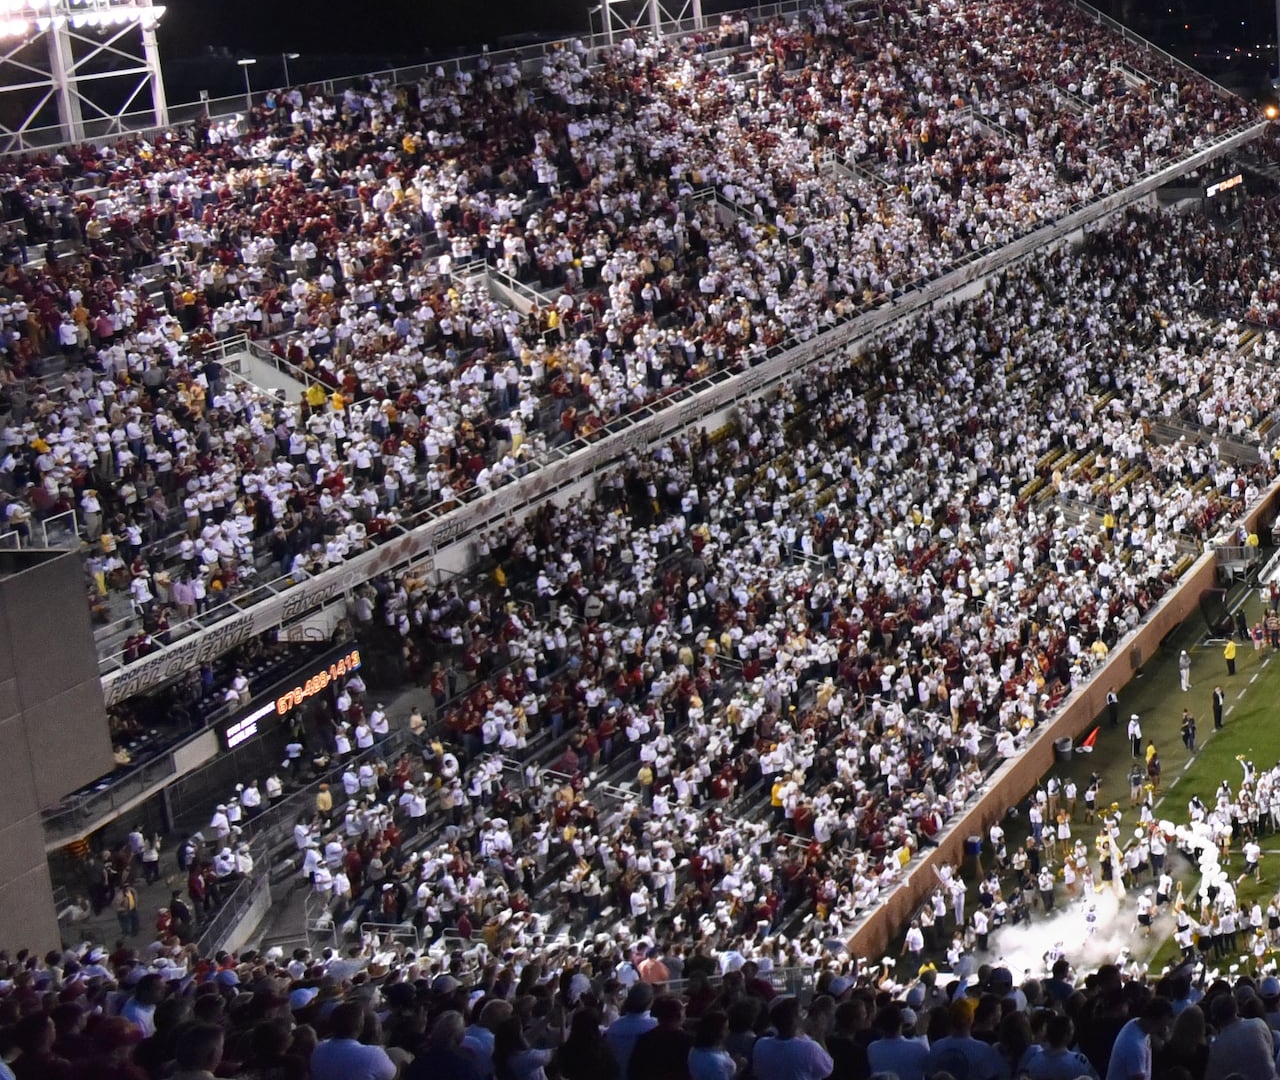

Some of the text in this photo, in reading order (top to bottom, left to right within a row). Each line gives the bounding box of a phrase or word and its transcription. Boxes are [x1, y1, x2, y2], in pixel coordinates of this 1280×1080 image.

[106, 623, 254, 705] HALL OF FAME
[111, 613, 255, 686] PROFESSIONAL FOOTBALL
